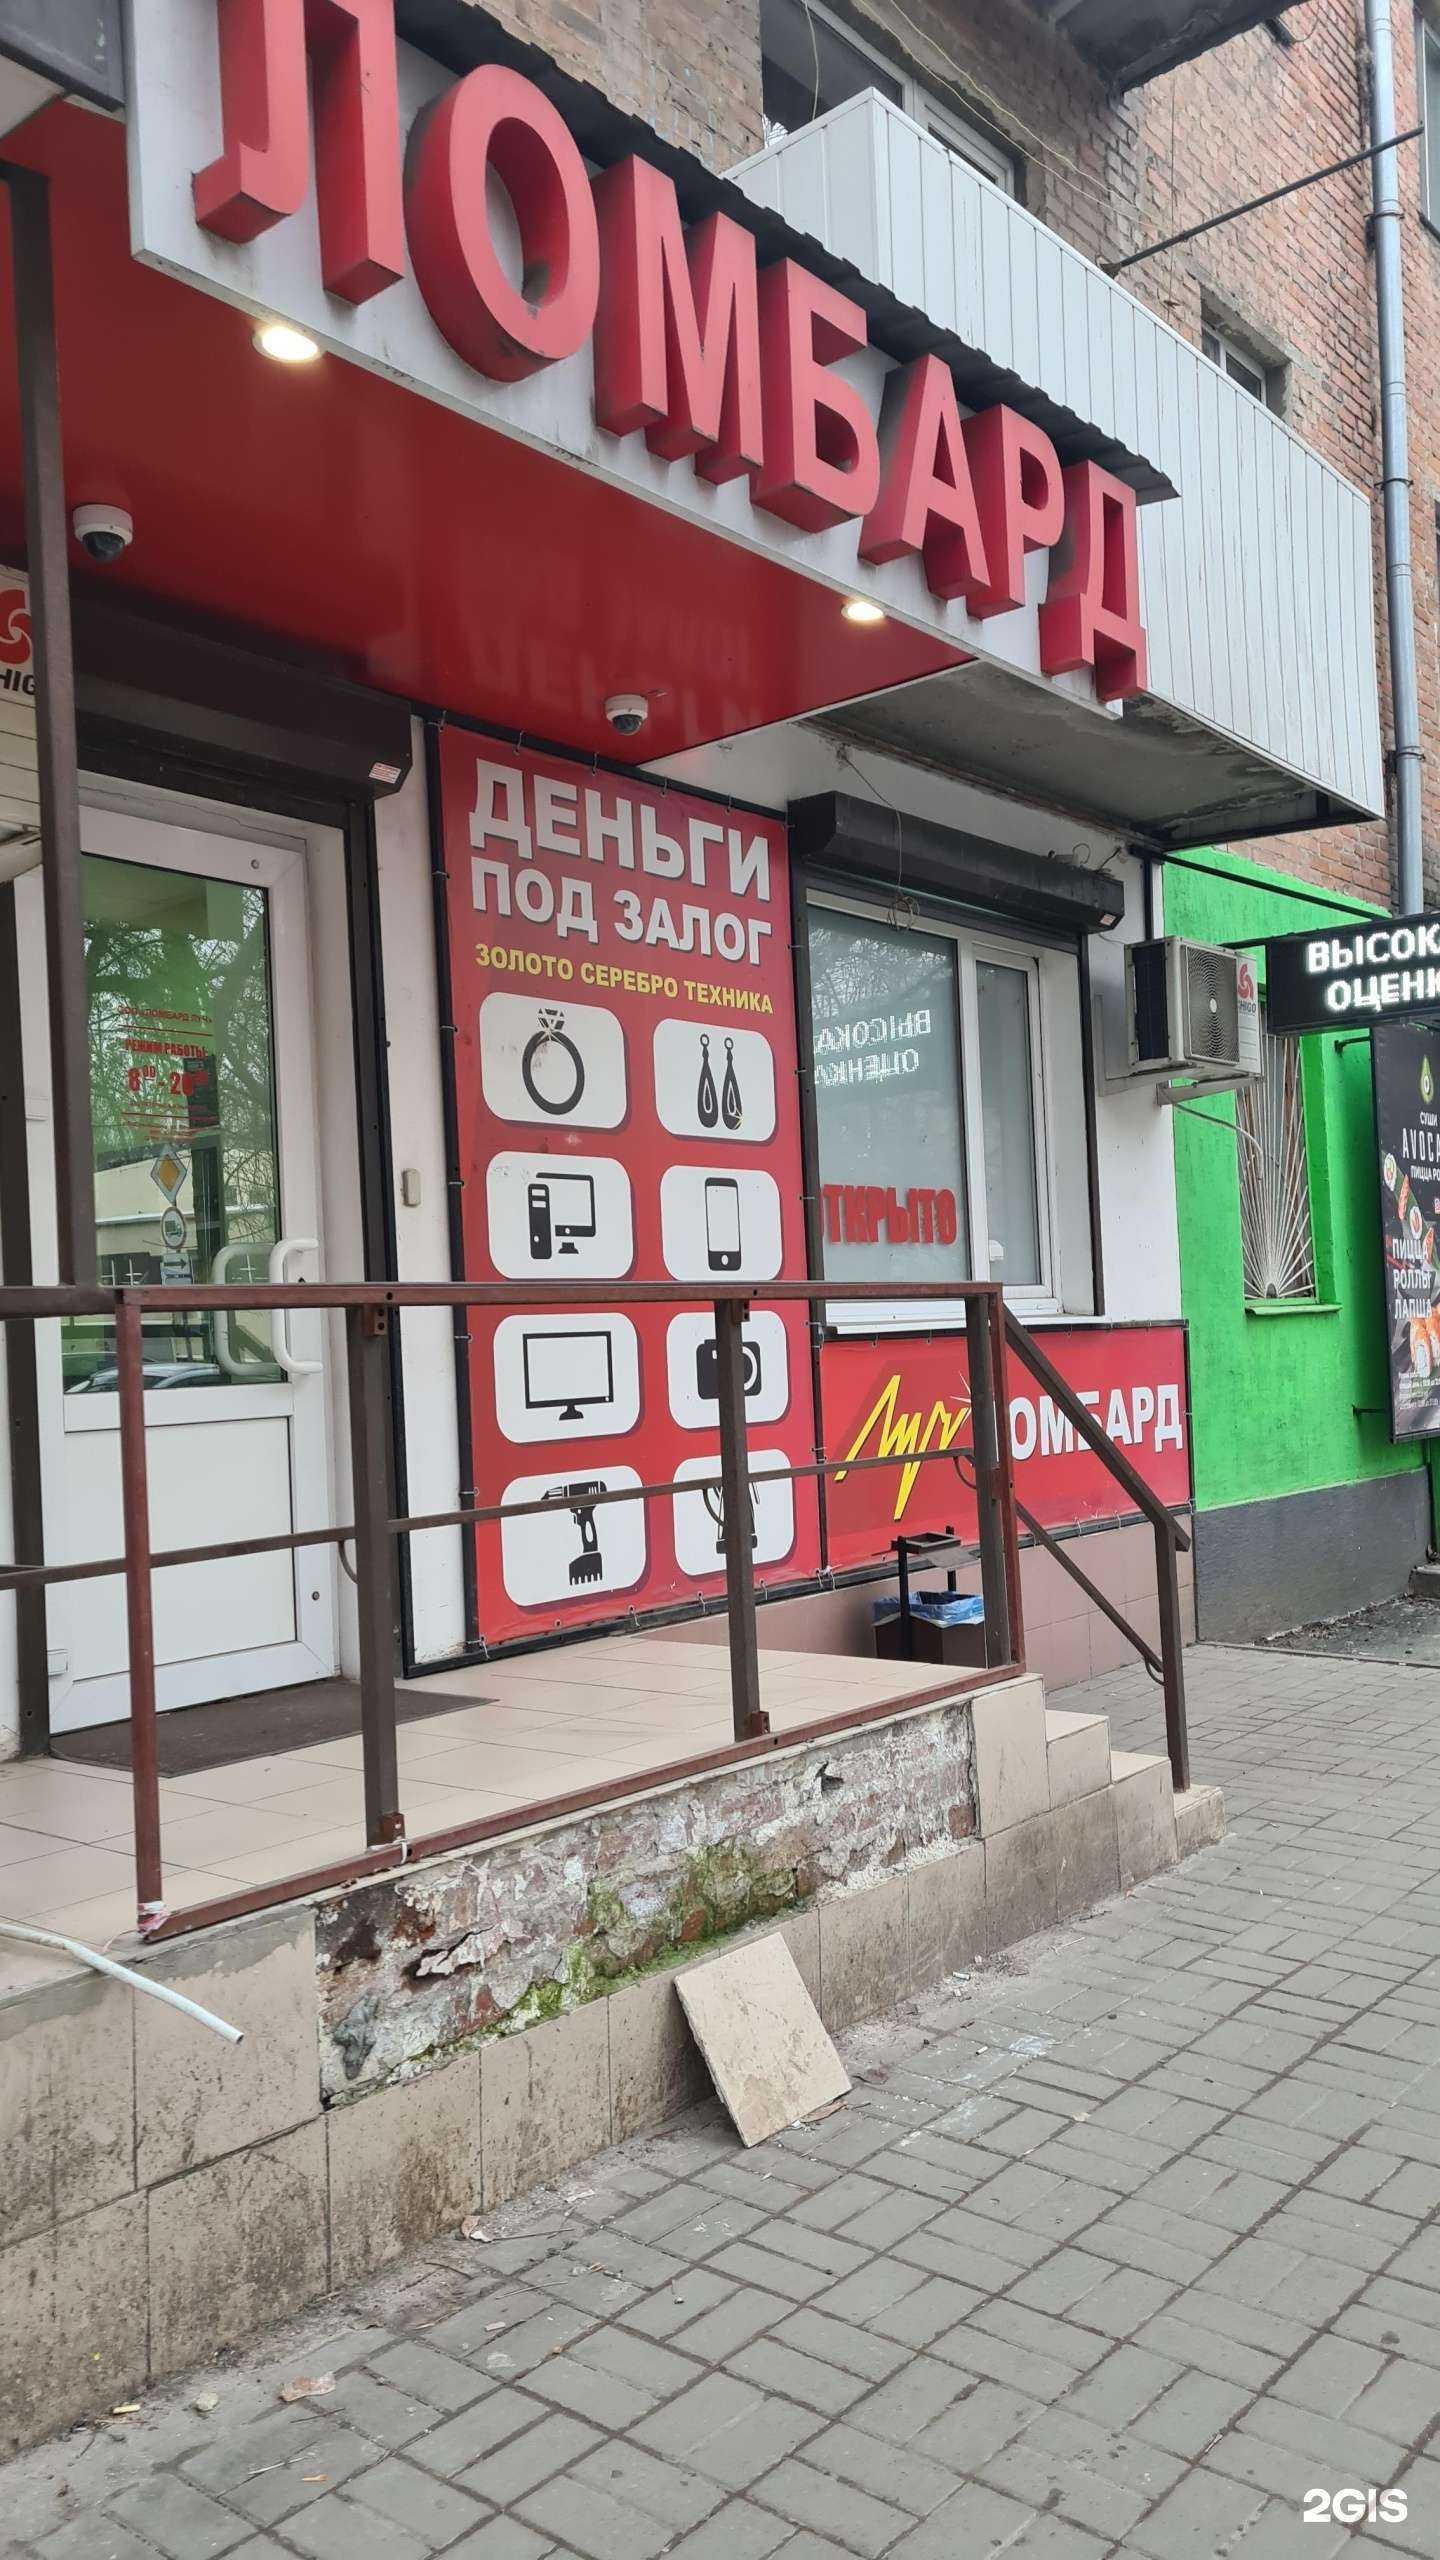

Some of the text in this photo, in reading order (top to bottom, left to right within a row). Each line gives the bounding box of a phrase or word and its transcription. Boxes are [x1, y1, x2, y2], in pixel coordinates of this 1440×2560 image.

[193, 0, 1147, 702] ЛОМБАРД
[0, 667, 37, 696] HIG
[468, 758, 771, 902] ДЕНЬГИ
[470, 856, 773, 966] ПОД ЗАЛОГ
[1307, 923, 1440, 974] ВЫСОК
[475, 943, 774, 1015] ЗОЛОТО СЕРЕБРО ТЕХНИКА
[820, 1183, 957, 1246] ТКРЫТО
[1392, 1238, 1430, 1263] ПИЦЦА
[1393, 1268, 1431, 1290] РОЛЛЫ
[1394, 1298, 1433, 1320] ЛАПША
